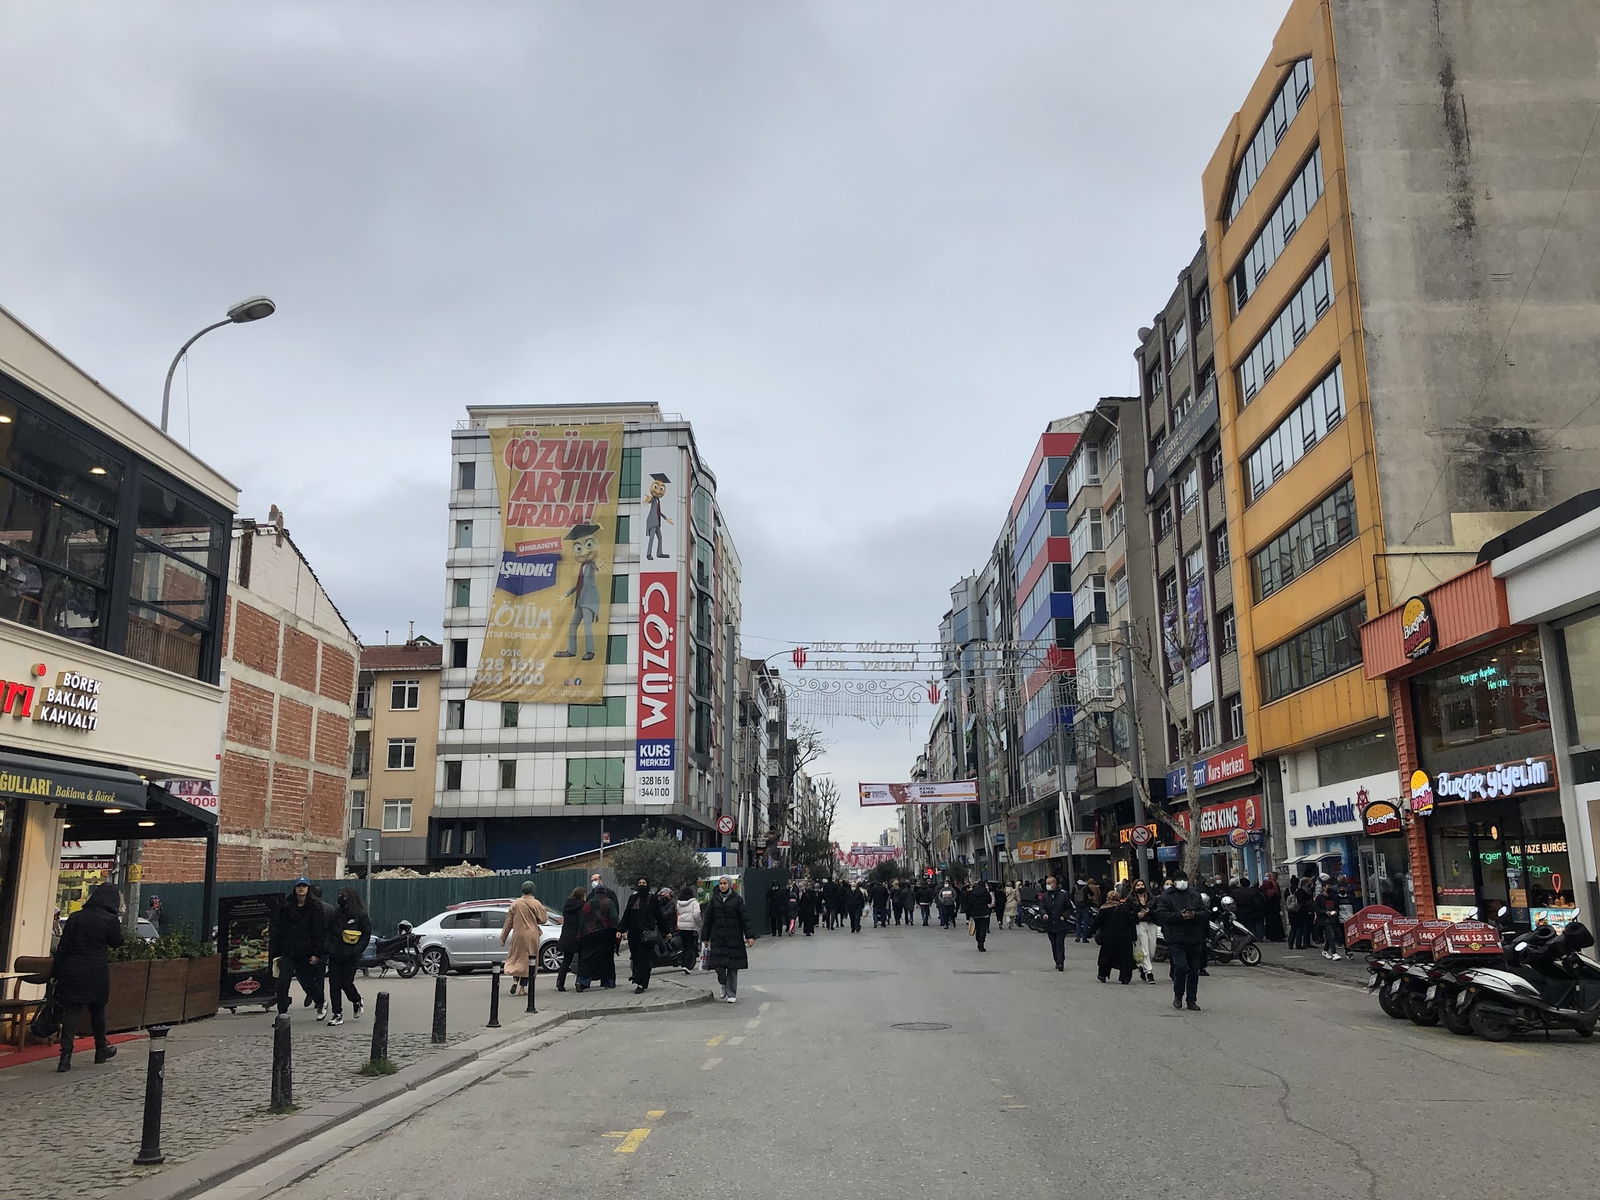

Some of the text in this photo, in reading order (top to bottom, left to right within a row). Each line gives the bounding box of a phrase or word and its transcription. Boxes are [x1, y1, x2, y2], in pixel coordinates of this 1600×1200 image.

[510, 471, 615, 503] ARTIK
[506, 503, 594, 528] URADA!
[641, 581, 674, 728] ÇÖZÜM
[63, 671, 101, 694] BÖREK
[47, 688, 98, 712] BAKLAVA
[40, 706, 98, 730] KAHVALTI
[640, 745, 671, 758] KURS
[640, 759, 670, 767] MERKEZİ
[1208, 764, 1221, 780] Kurs
[1221, 754, 1245, 778] Merkezi
[56, 786, 85, 800] Baklava
[87, 790, 94, 801] &
[95, 791, 116, 803] Börek
[1217, 805, 1239, 829] KING
[1306, 797, 1357, 828] DenizBank
[496, 866, 532, 877] mavi
